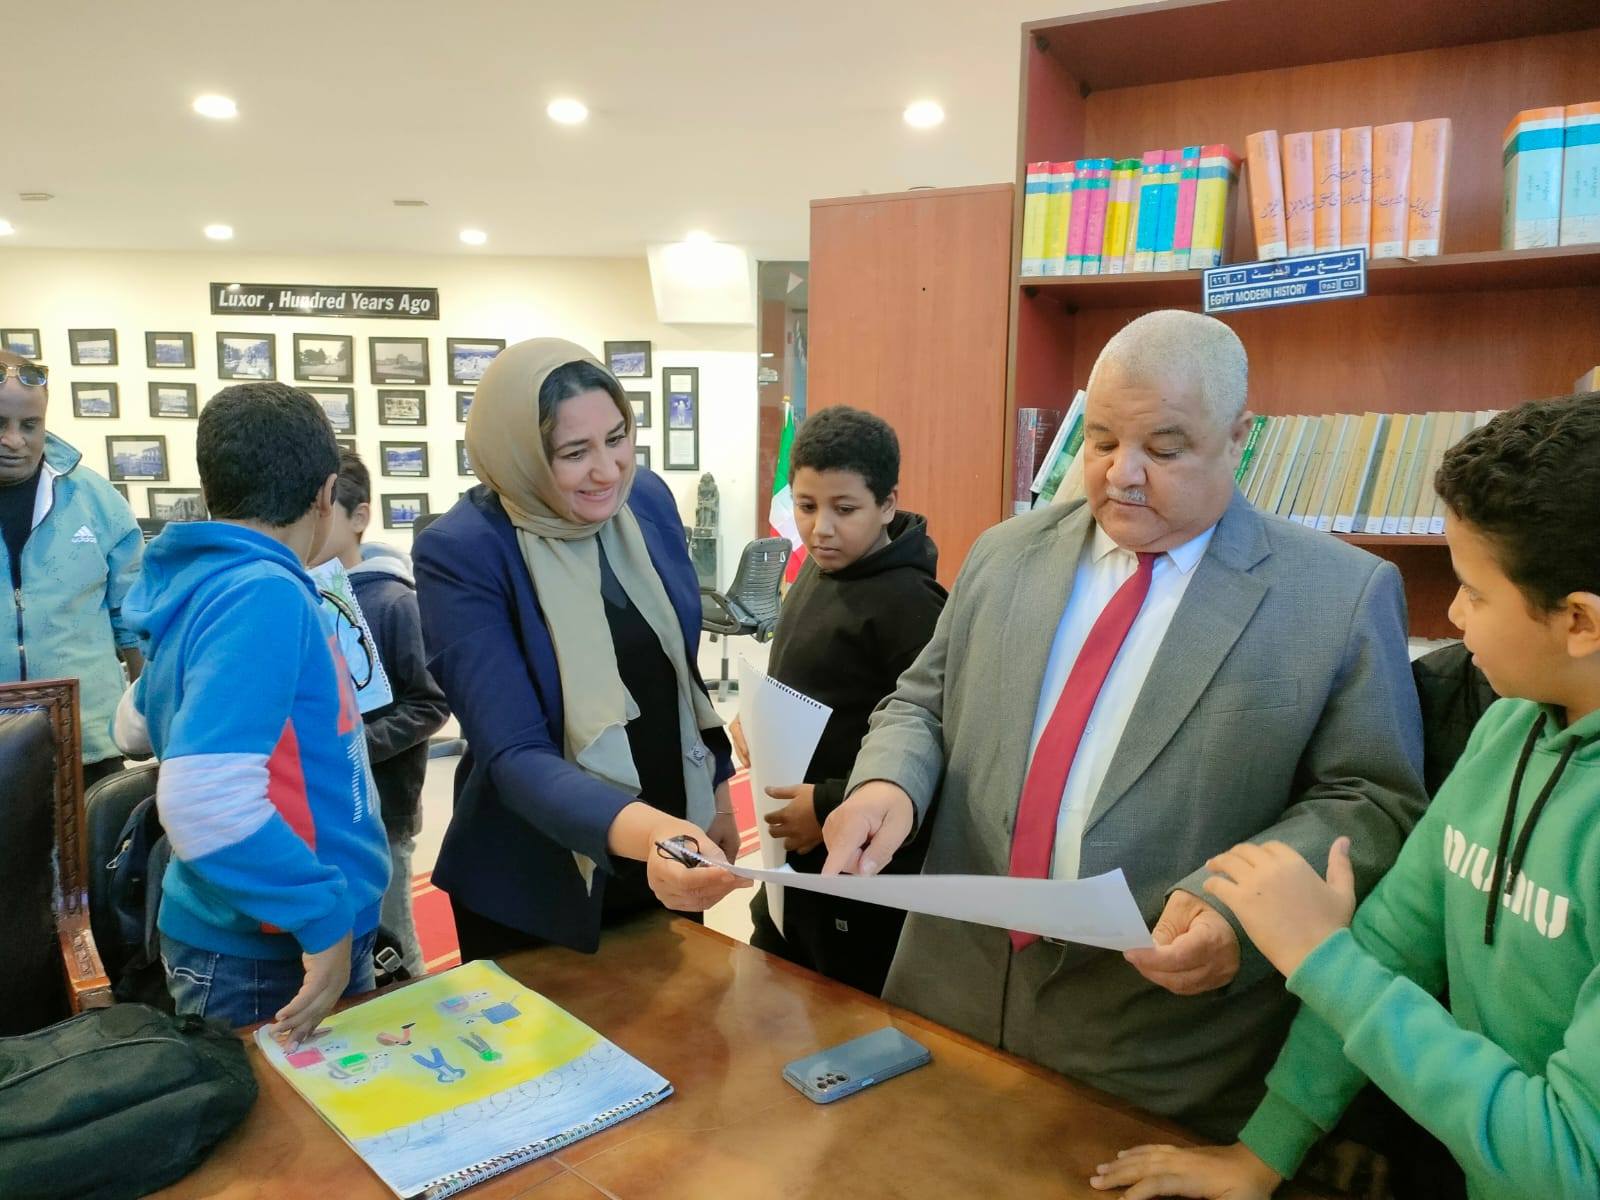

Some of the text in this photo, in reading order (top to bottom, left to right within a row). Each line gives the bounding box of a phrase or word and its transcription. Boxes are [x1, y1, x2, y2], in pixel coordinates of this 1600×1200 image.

[1294, 265, 1315, 276] مصر
[1318, 257, 1356, 274] تاريخ
[219, 289, 265, 308] Luxor
[279, 290, 346, 310] Hundred
[351, 292, 395, 311] Years
[398, 294, 431, 314] Ago
[1210, 293, 1234, 306] EGYPT
[1235, 286, 1273, 302] MODERN
[1273, 283, 1307, 298] HISTORY
